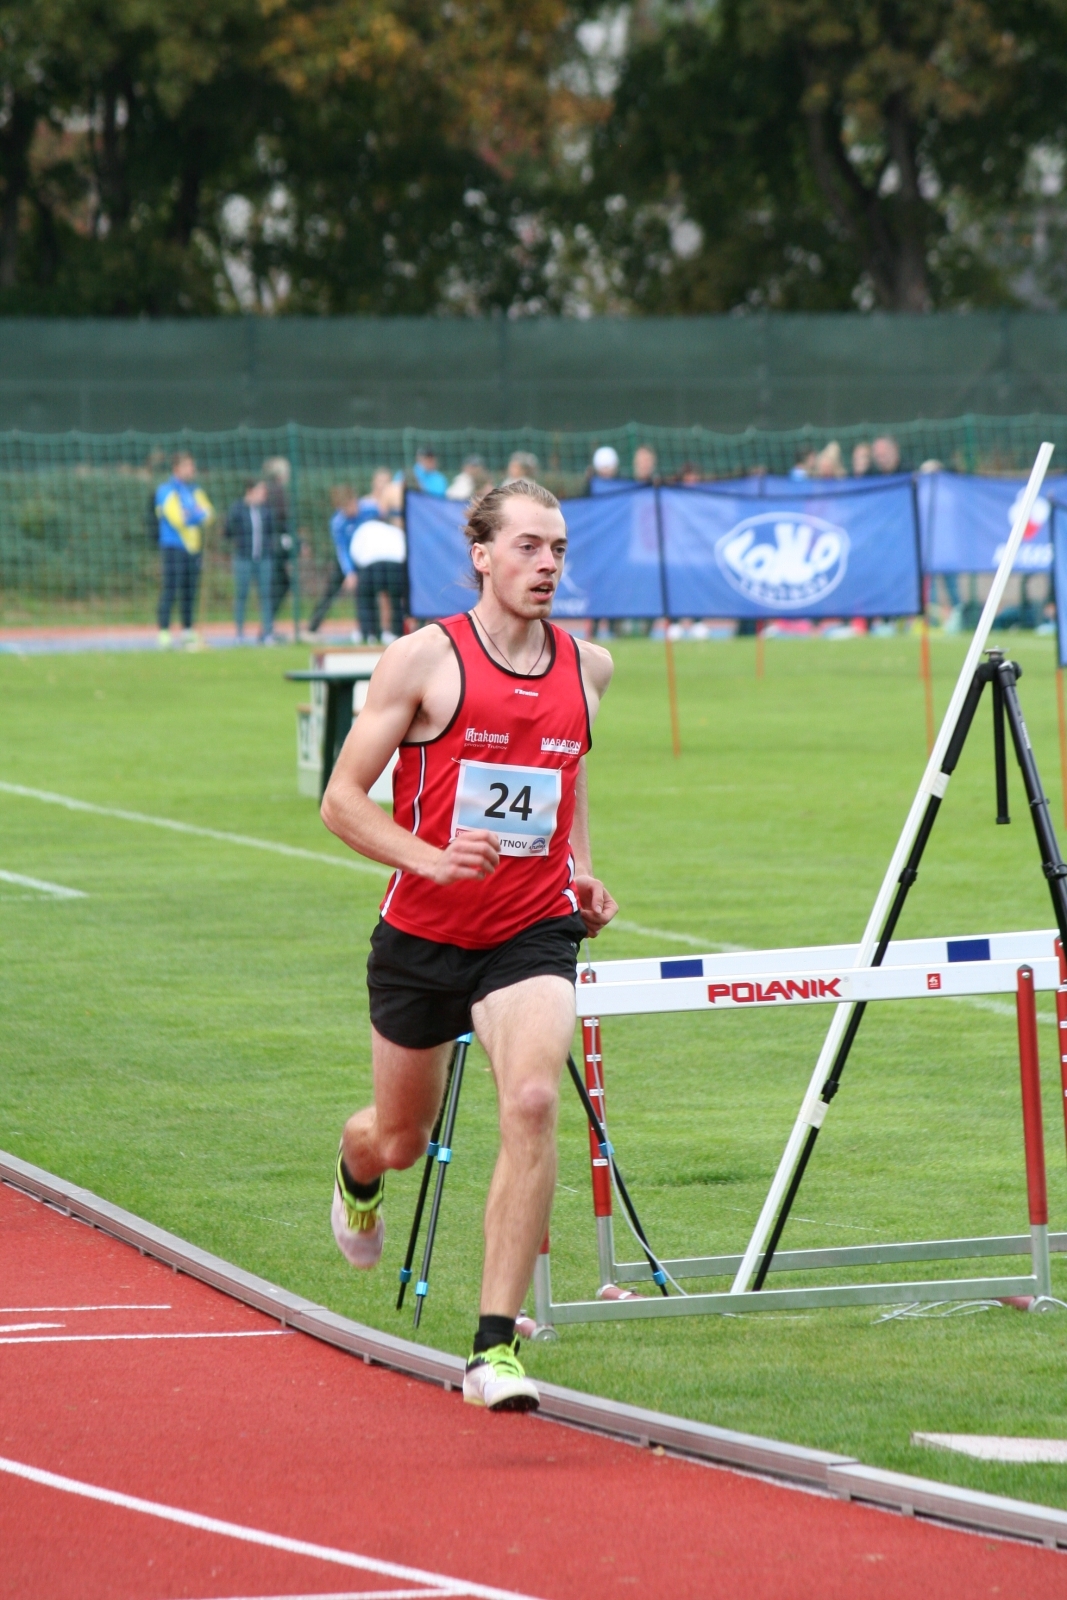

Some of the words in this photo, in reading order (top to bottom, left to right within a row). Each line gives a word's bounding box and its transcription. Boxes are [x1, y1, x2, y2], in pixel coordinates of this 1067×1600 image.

[541, 737, 581, 750] MARATON
[484, 782, 533, 821] 24
[707, 978, 843, 1004] POLANIK
